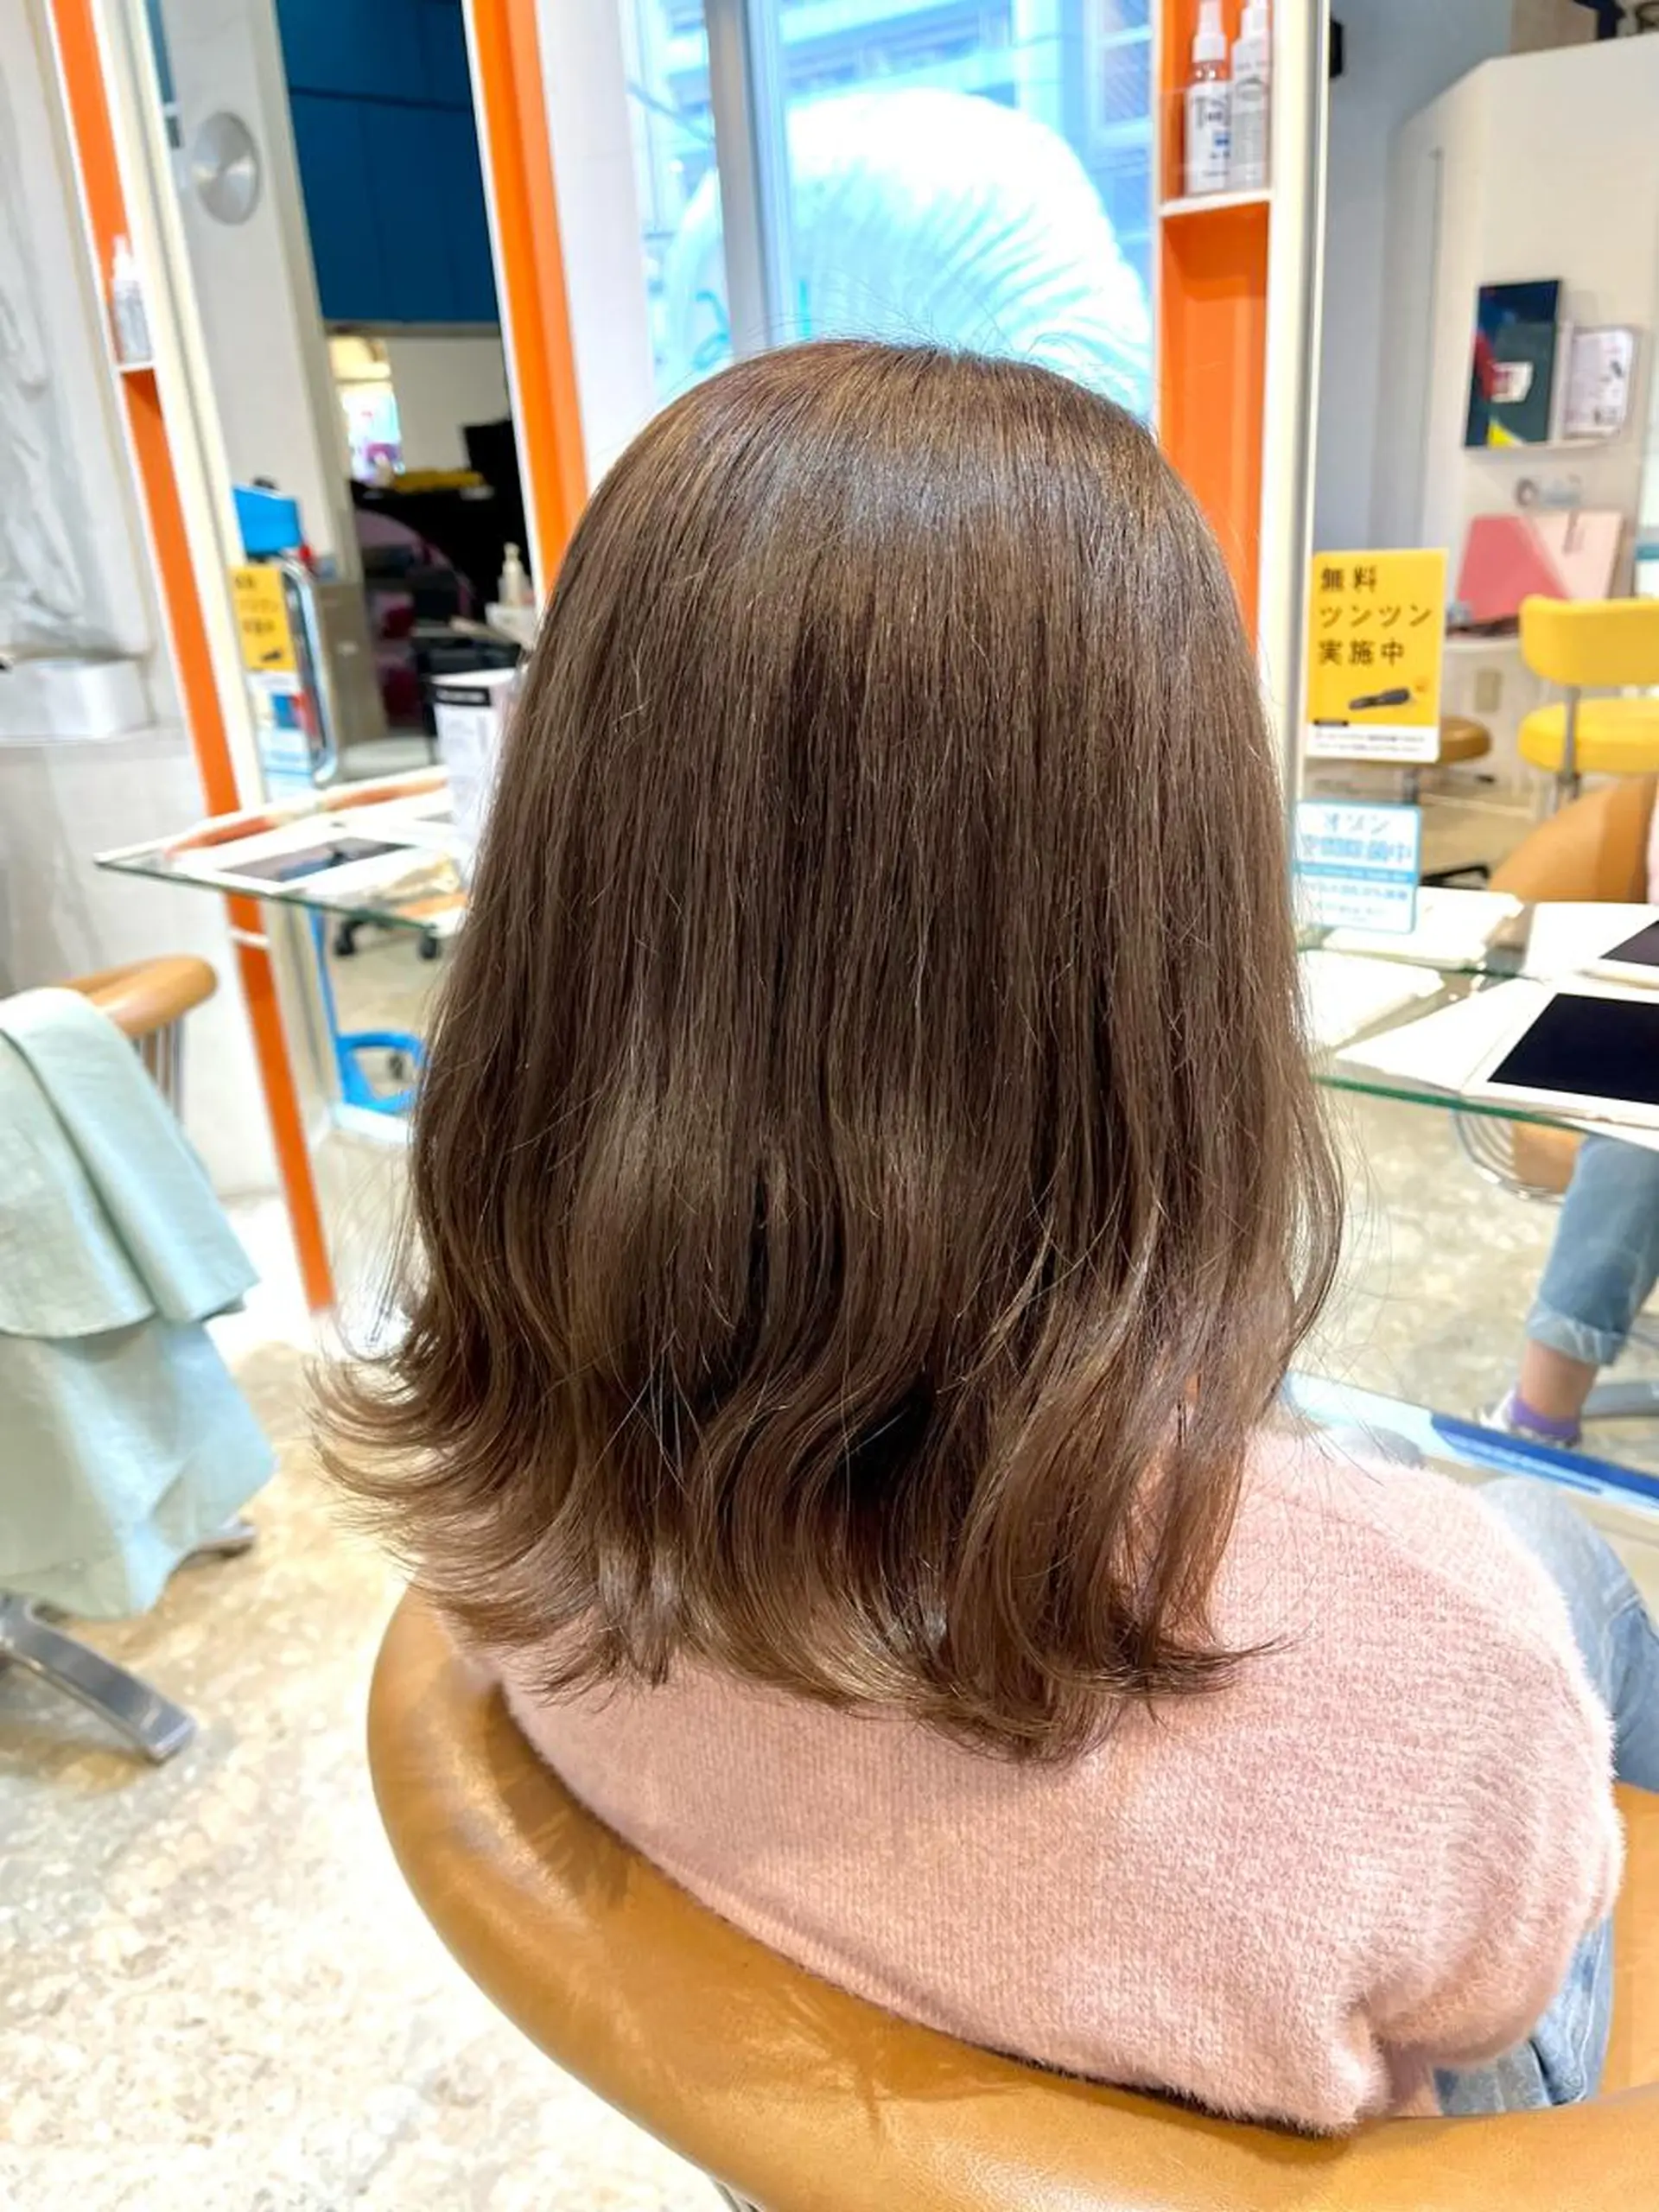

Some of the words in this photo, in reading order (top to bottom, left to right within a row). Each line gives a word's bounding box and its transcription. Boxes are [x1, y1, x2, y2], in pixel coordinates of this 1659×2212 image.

[1320, 565, 1378, 593] 無料
[1319, 605, 1433, 628] ツンツン
[1319, 638, 1405, 666] 実施中
